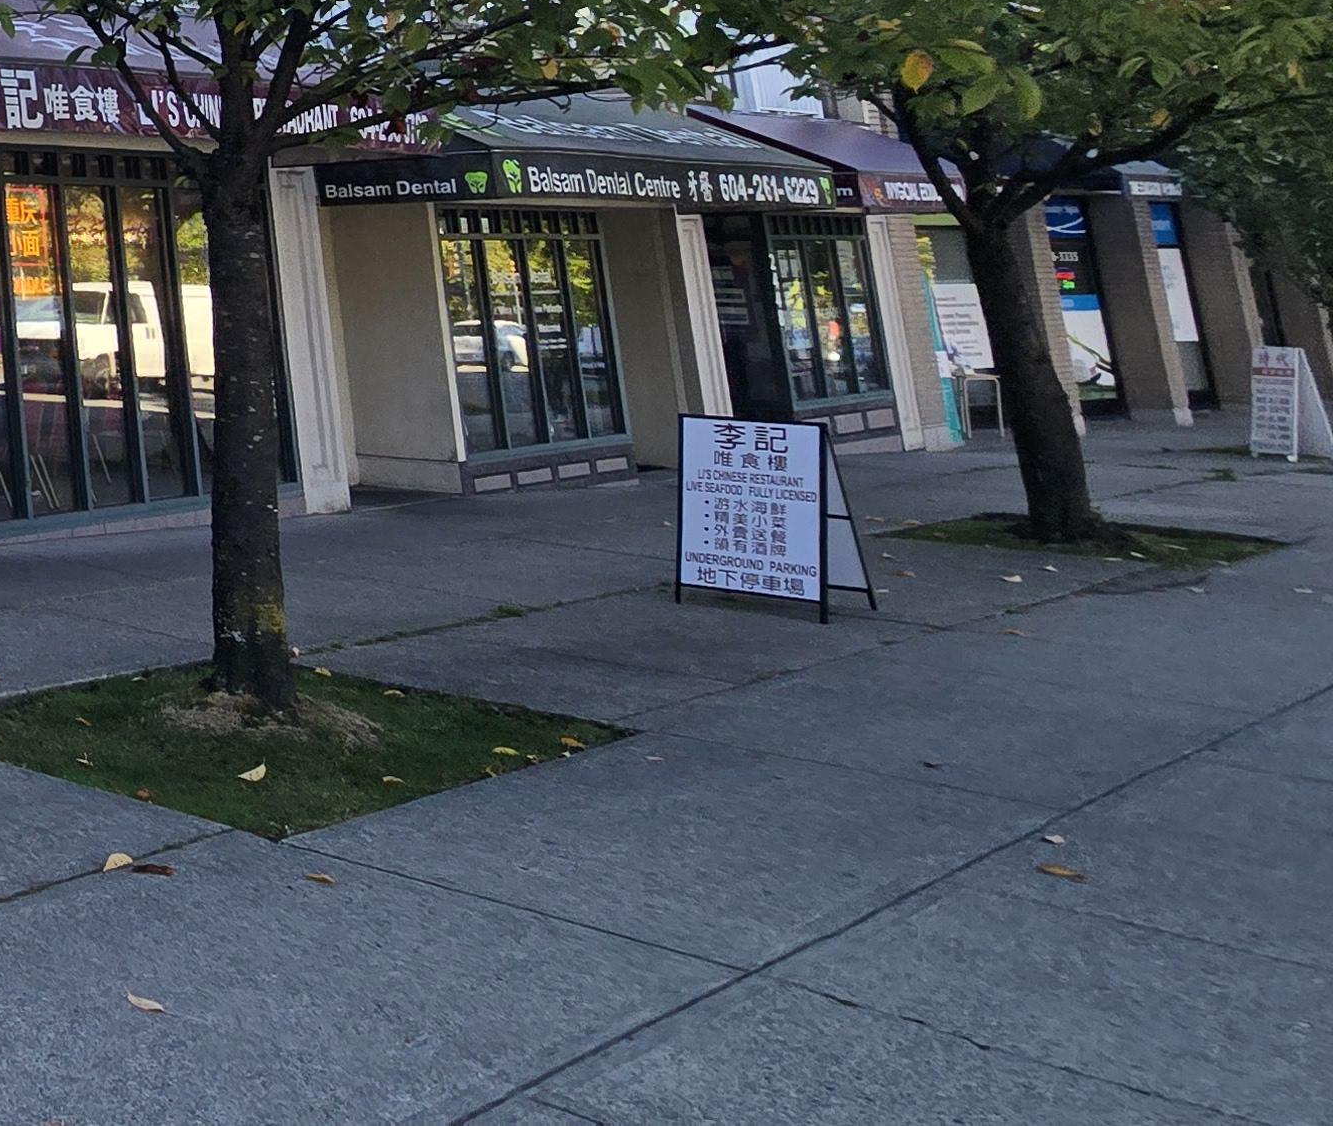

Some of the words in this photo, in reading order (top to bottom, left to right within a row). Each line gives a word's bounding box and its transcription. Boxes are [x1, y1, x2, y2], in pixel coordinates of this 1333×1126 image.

[325, 183, 392, 199] Balsam
[396, 177, 458, 197] Dental
[526, 165, 587, 194] Balsam
[586, 168, 634, 196] Dental
[634, 170, 682, 199] Centre
[718, 173, 821, 205] 604-261-6229
[713, 423, 789, 453] 李記
[713, 450, 788, 472] 唯食樓
[697, 469, 712, 479] LI'S
[713, 469, 748, 483] CHINESE
[749, 472, 804, 488] RESTAURANT
[686, 481, 703, 491] LIVE
[705, 482, 743, 495] SEAFOOD
[748, 486, 774, 499] FULLY
[775, 489, 818, 503] LICENSED
[685, 551, 764, 571] UNDERGROUND
[769, 561, 818, 577] PARKING
[697, 566, 806, 596] 地下停車場
